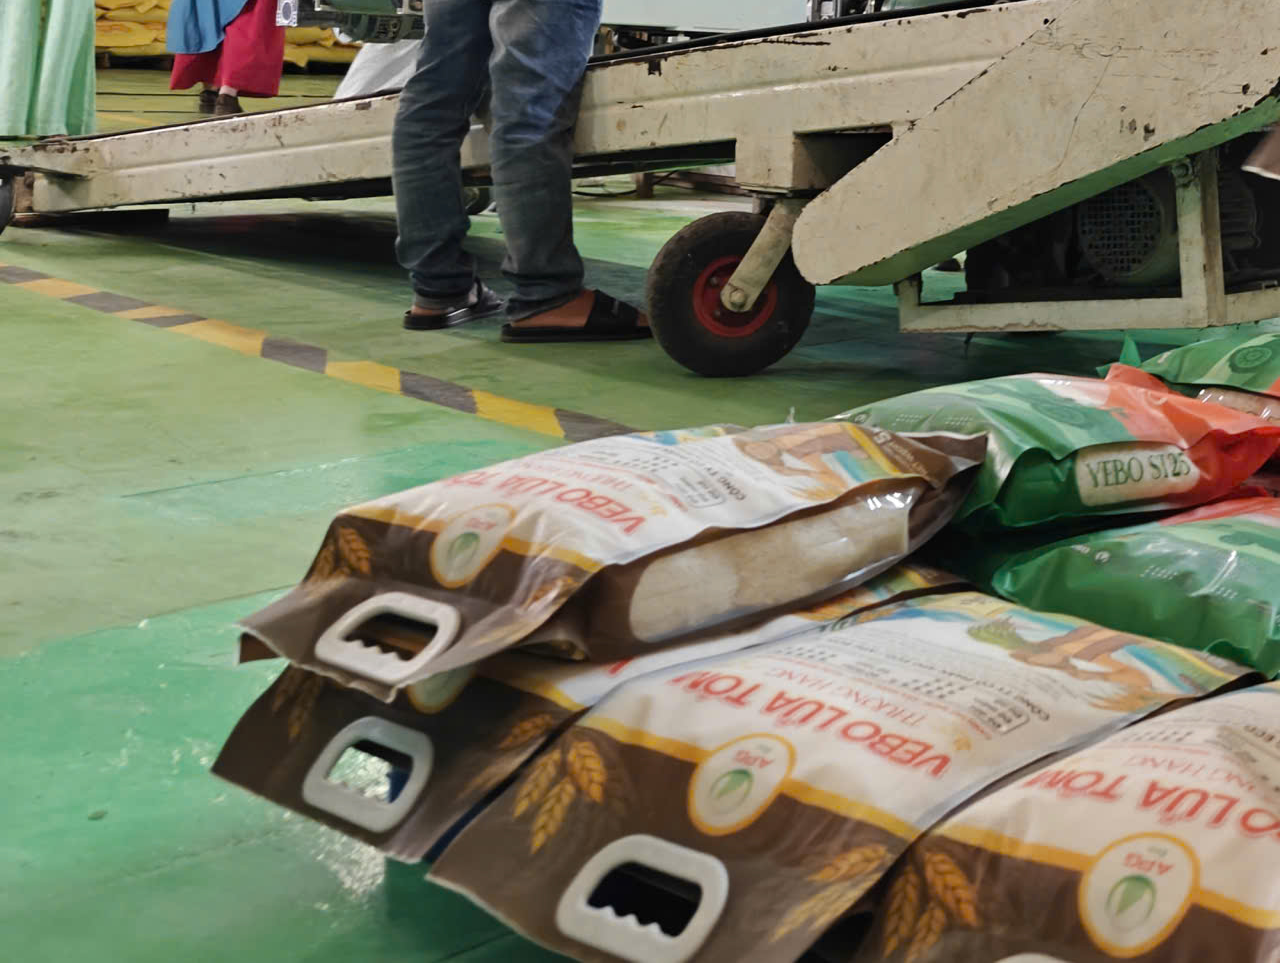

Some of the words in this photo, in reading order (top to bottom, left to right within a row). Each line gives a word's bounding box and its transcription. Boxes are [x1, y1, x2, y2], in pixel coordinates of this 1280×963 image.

[1086, 456, 1144, 488] VEBO
[1148, 451, 1192, 481] ST25
[556, 488, 646, 535] VEBO
[839, 720, 952, 780] VEBO
[1123, 851, 1175, 878] APG
